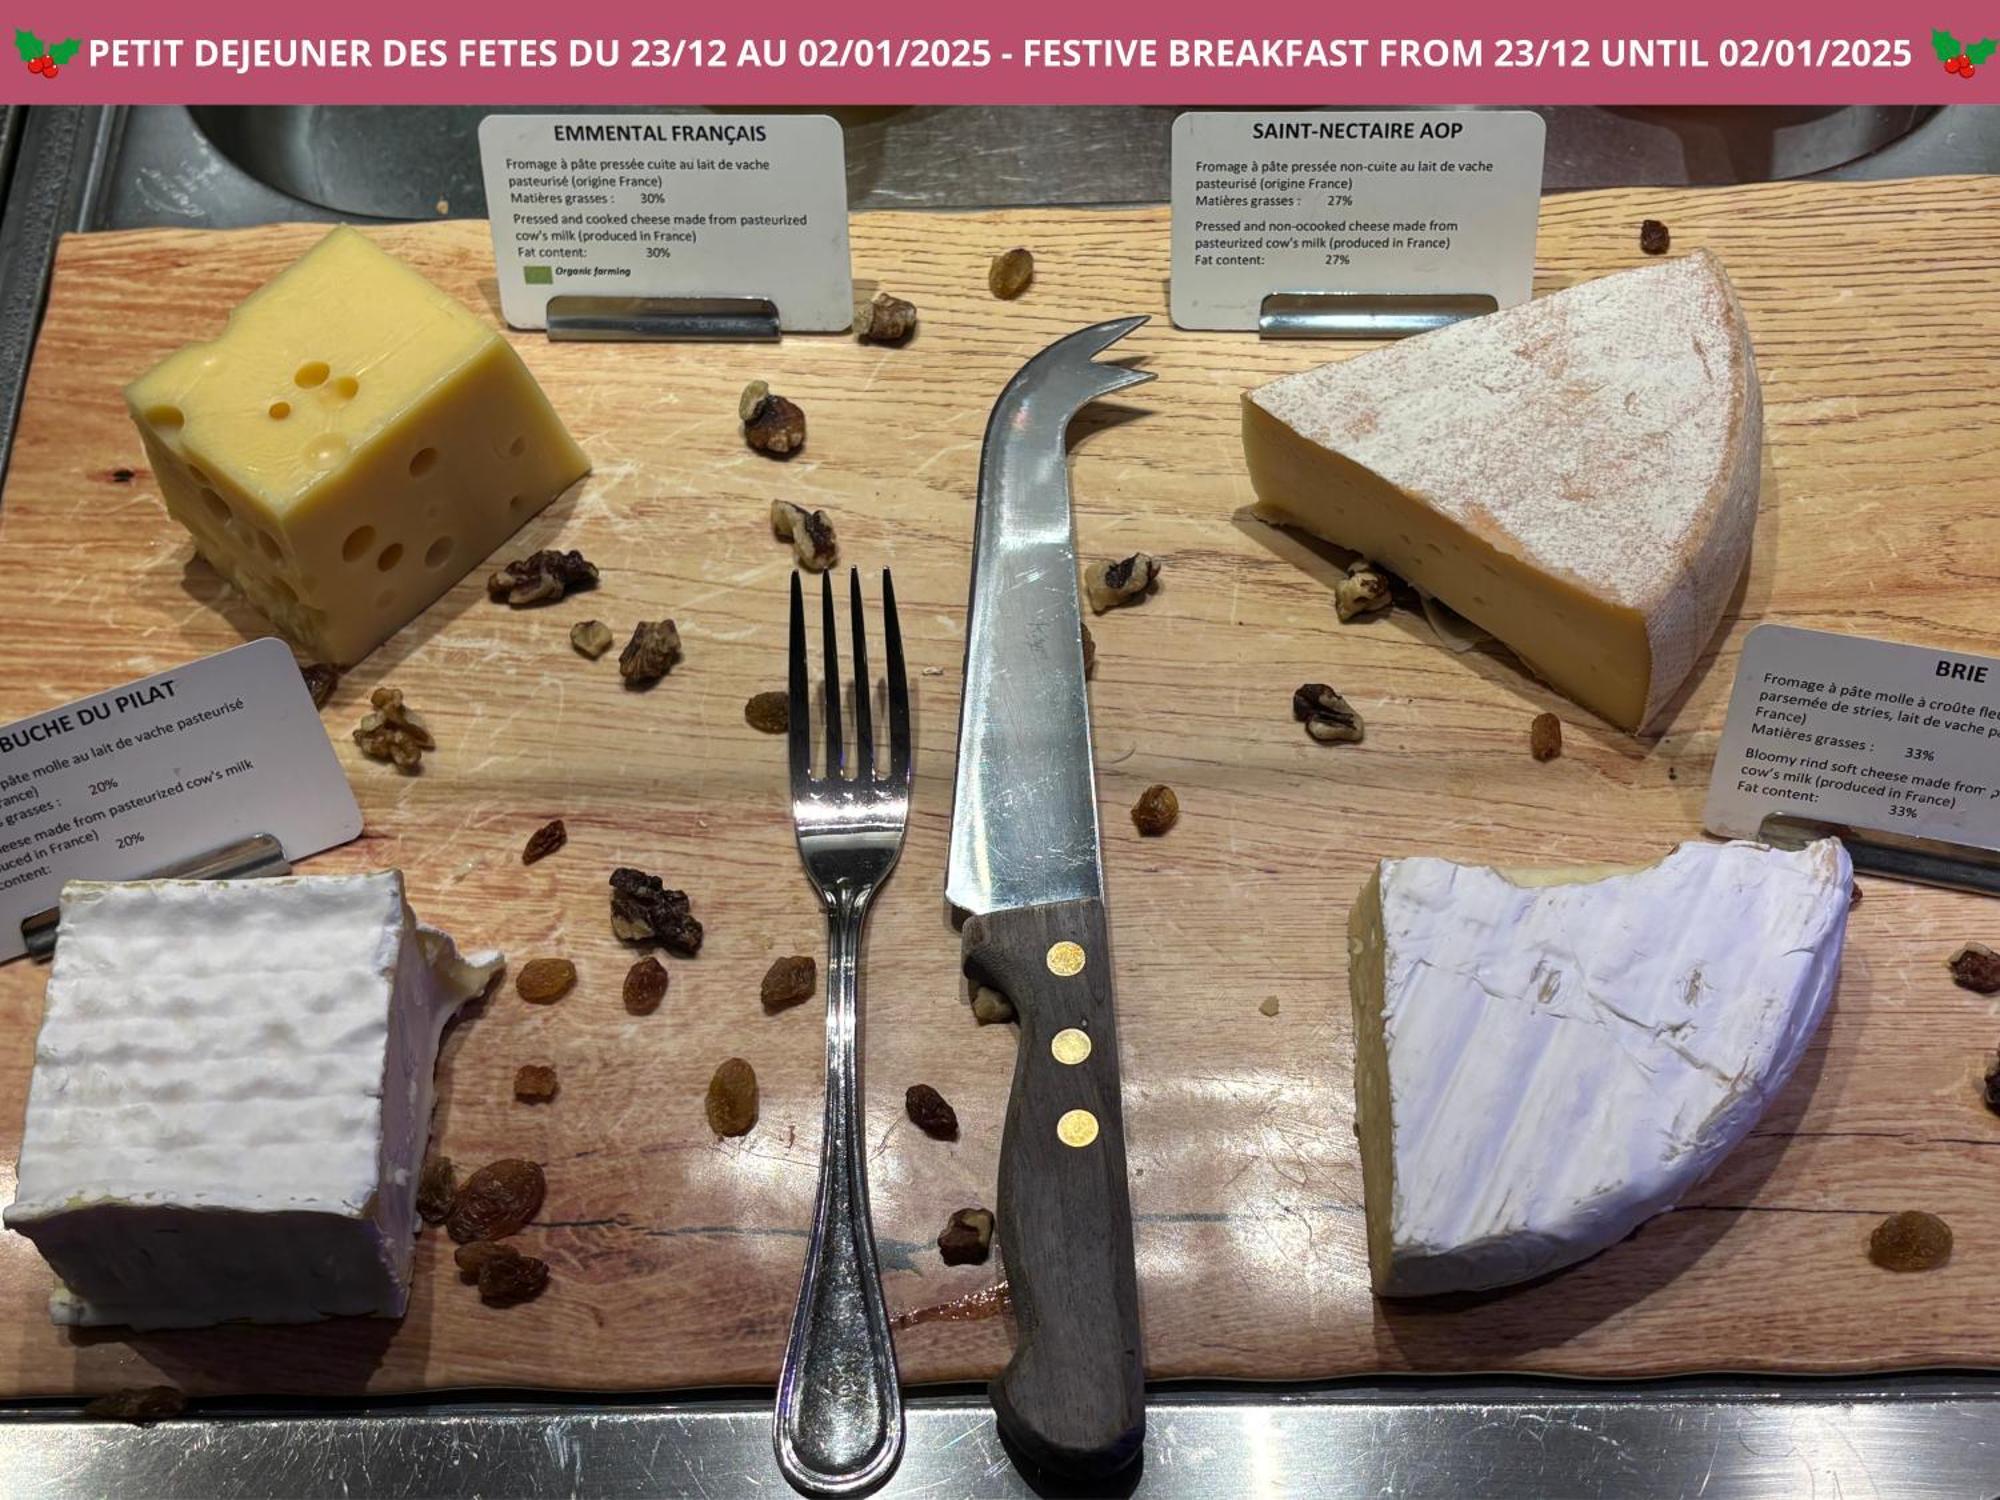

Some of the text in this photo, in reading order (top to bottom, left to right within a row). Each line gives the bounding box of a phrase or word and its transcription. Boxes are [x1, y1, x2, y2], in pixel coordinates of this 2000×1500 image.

[553, 125, 767, 146] EMMENTAL FRANÇAIS
[1252, 121, 1463, 139] SAINT-NECTAIRE AOP
[505, 157, 770, 173] Fromage à pâte pressée cuite au lait de vache
[1195, 160, 1493, 175] Fromage à pâte pressée non-cuite au lait de vache
[508, 174, 663, 189] pasteurisé (origine France)
[1195, 177, 1353, 192] pasteurisé (origine France)
[510, 191, 563, 204] Matières
[564, 194, 608, 206] grasses
[639, 192, 666, 204] 30%
[1195, 194, 1249, 206] Matières
[1250, 196, 1294, 209] grasses
[1327, 194, 1353, 206] 27%
[512, 212, 807, 227] Pressed and cooked cheese made from pasteurized
[1195, 219, 1458, 232] Pressed and non-ocooked cheese made from
[550, 229, 576, 241] milk
[577, 229, 638, 244] (produced
[639, 230, 651, 241] in
[653, 230, 697, 244] France)
[1194, 236, 1263, 251] pasteurized
[1301, 236, 1326, 248] milk
[1328, 236, 1390, 251] (produced
[1392, 237, 1404, 248] in
[1407, 236, 1450, 250] France)
[517, 246, 671, 258] Fat content: 30%
[1194, 254, 1350, 266] Fat content: 27%
[554, 266, 592, 277] Organic
[1935, 660, 1989, 683] BRIE
[1763, 672, 1825, 693] Fromage
[1827, 681, 1837, 694] à
[1839, 685, 1872, 700] pâte
[1874, 692, 1915, 706] molle
[1916, 696, 1926, 708] à
[1928, 700, 1976, 716] croûte
[0, 679, 175, 753] BUCHE DU PILAT
[1755, 705, 1807, 726] France)
[1759, 691, 1828, 710] parsemée
[1831, 700, 1849, 713] de
[1852, 705, 1893, 722] stries,
[1896, 709, 1920, 725] lait
[1922, 714, 1941, 728] de
[1944, 720, 1985, 735] vache
[0, 697, 244, 792] pâte molle au lait de vache pasteurisé
[1751, 722, 1813, 742] Matières
[1813, 735, 1866, 751] grasses
[1904, 747, 1935, 762] 33%
[1745, 747, 1798, 767] Bloomy
[1799, 756, 1829, 770] rind
[1829, 763, 1858, 776] soft
[1860, 765, 1909, 784] cheese
[1910, 776, 1951, 790] made
[0, 785, 39, 810] ance)
[1736, 780, 1918, 819] Fat content: 33%
[1782, 772, 1813, 785] milk
[1815, 774, 1886, 797] (produced
[1887, 787, 1902, 799] in
[1904, 789, 1956, 810] France)
[0, 836, 32, 854] eese
[33, 822, 72, 842] made
[72, 810, 107, 828] from
[108, 781, 184, 819] pasteurized
[224, 759, 254, 777] milk
[4, 801, 54, 826] grasses
[87, 777, 119, 796] 20%
[0, 828, 100, 873] uced in France)
[114, 831, 145, 850] 20%
